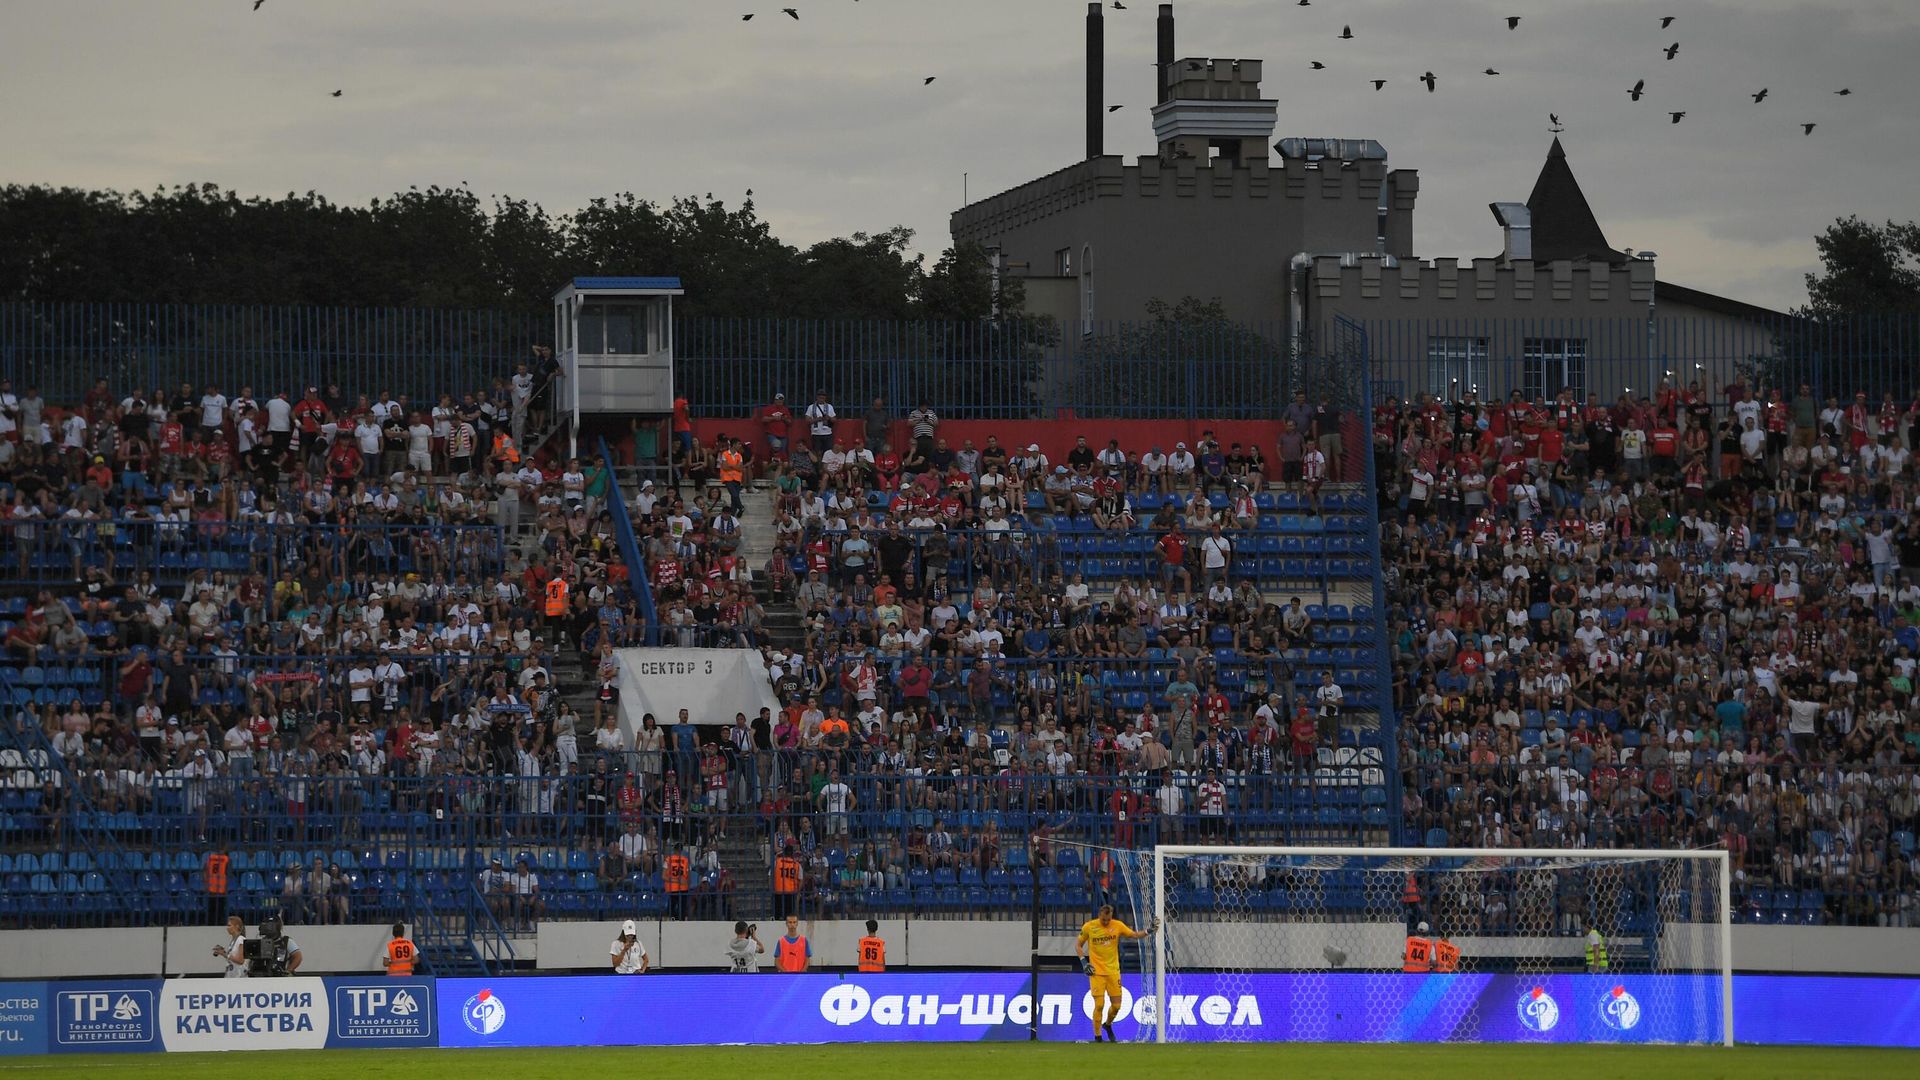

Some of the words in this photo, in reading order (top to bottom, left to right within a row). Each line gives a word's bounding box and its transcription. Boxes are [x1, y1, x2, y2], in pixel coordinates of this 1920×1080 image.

[641, 661, 695, 675] СЕКТОР
[705, 660, 713, 675] 3
[395, 945, 410, 959] 69
[865, 947, 878, 960] 85
[1411, 948, 1425, 961] 44
[68, 994, 109, 1021] ТР
[175, 993, 312, 1010] ТЕРРИТОРИЯ
[347, 989, 387, 1016] ТР
[819, 983, 1073, 1026] Фан-шоп
[69, 1023, 142, 1031] ТехноРесурс
[176, 1013, 314, 1034] КАЧЕСТВА
[69, 1032, 142, 1041] ИНТЕРНЕШНЛ
[348, 1027, 420, 1035] ИНТЕРНЕШНЛ
